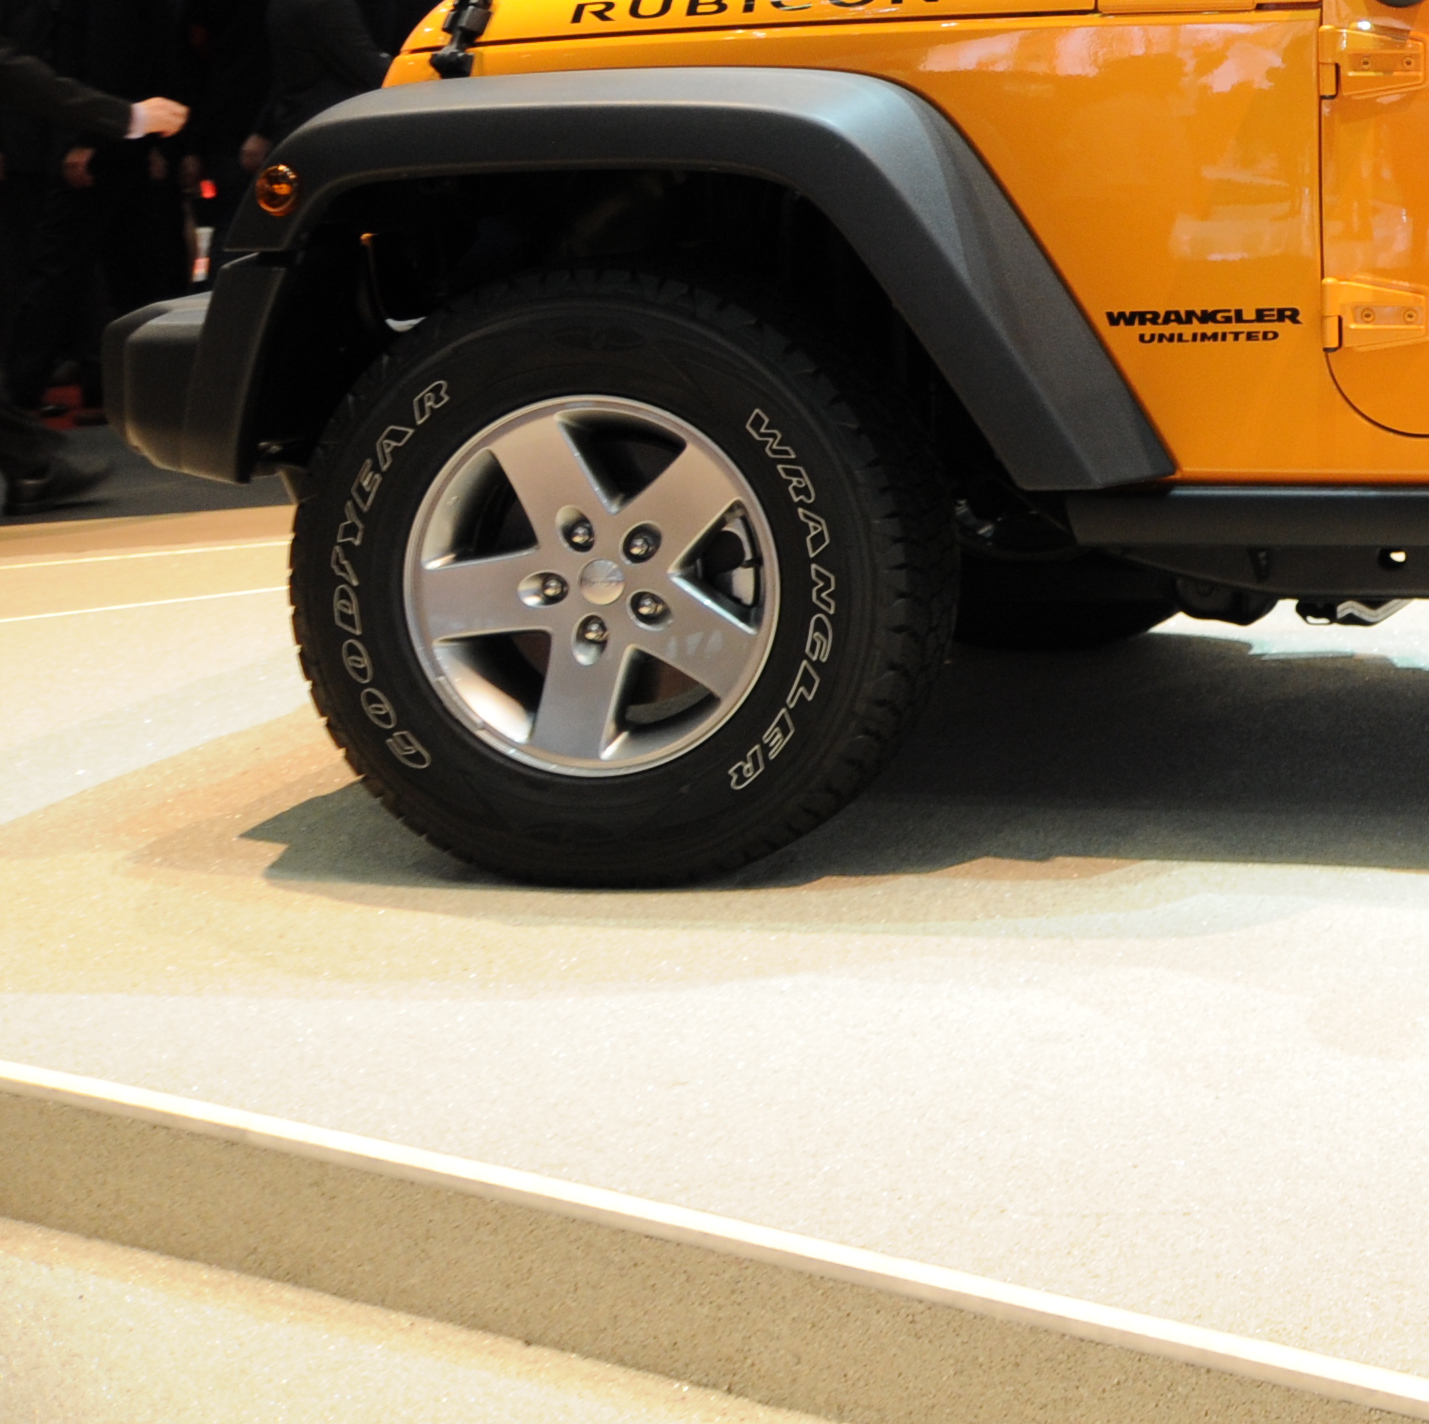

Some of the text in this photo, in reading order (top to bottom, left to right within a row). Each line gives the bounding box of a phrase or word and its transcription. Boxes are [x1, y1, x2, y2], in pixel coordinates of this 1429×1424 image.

[1105, 307, 1303, 326] WRANGLER
[1138, 330, 1279, 344] UNLIMITED
[330, 379, 451, 770] GOODYEAR
[728, 408, 836, 790] WRANGLER
